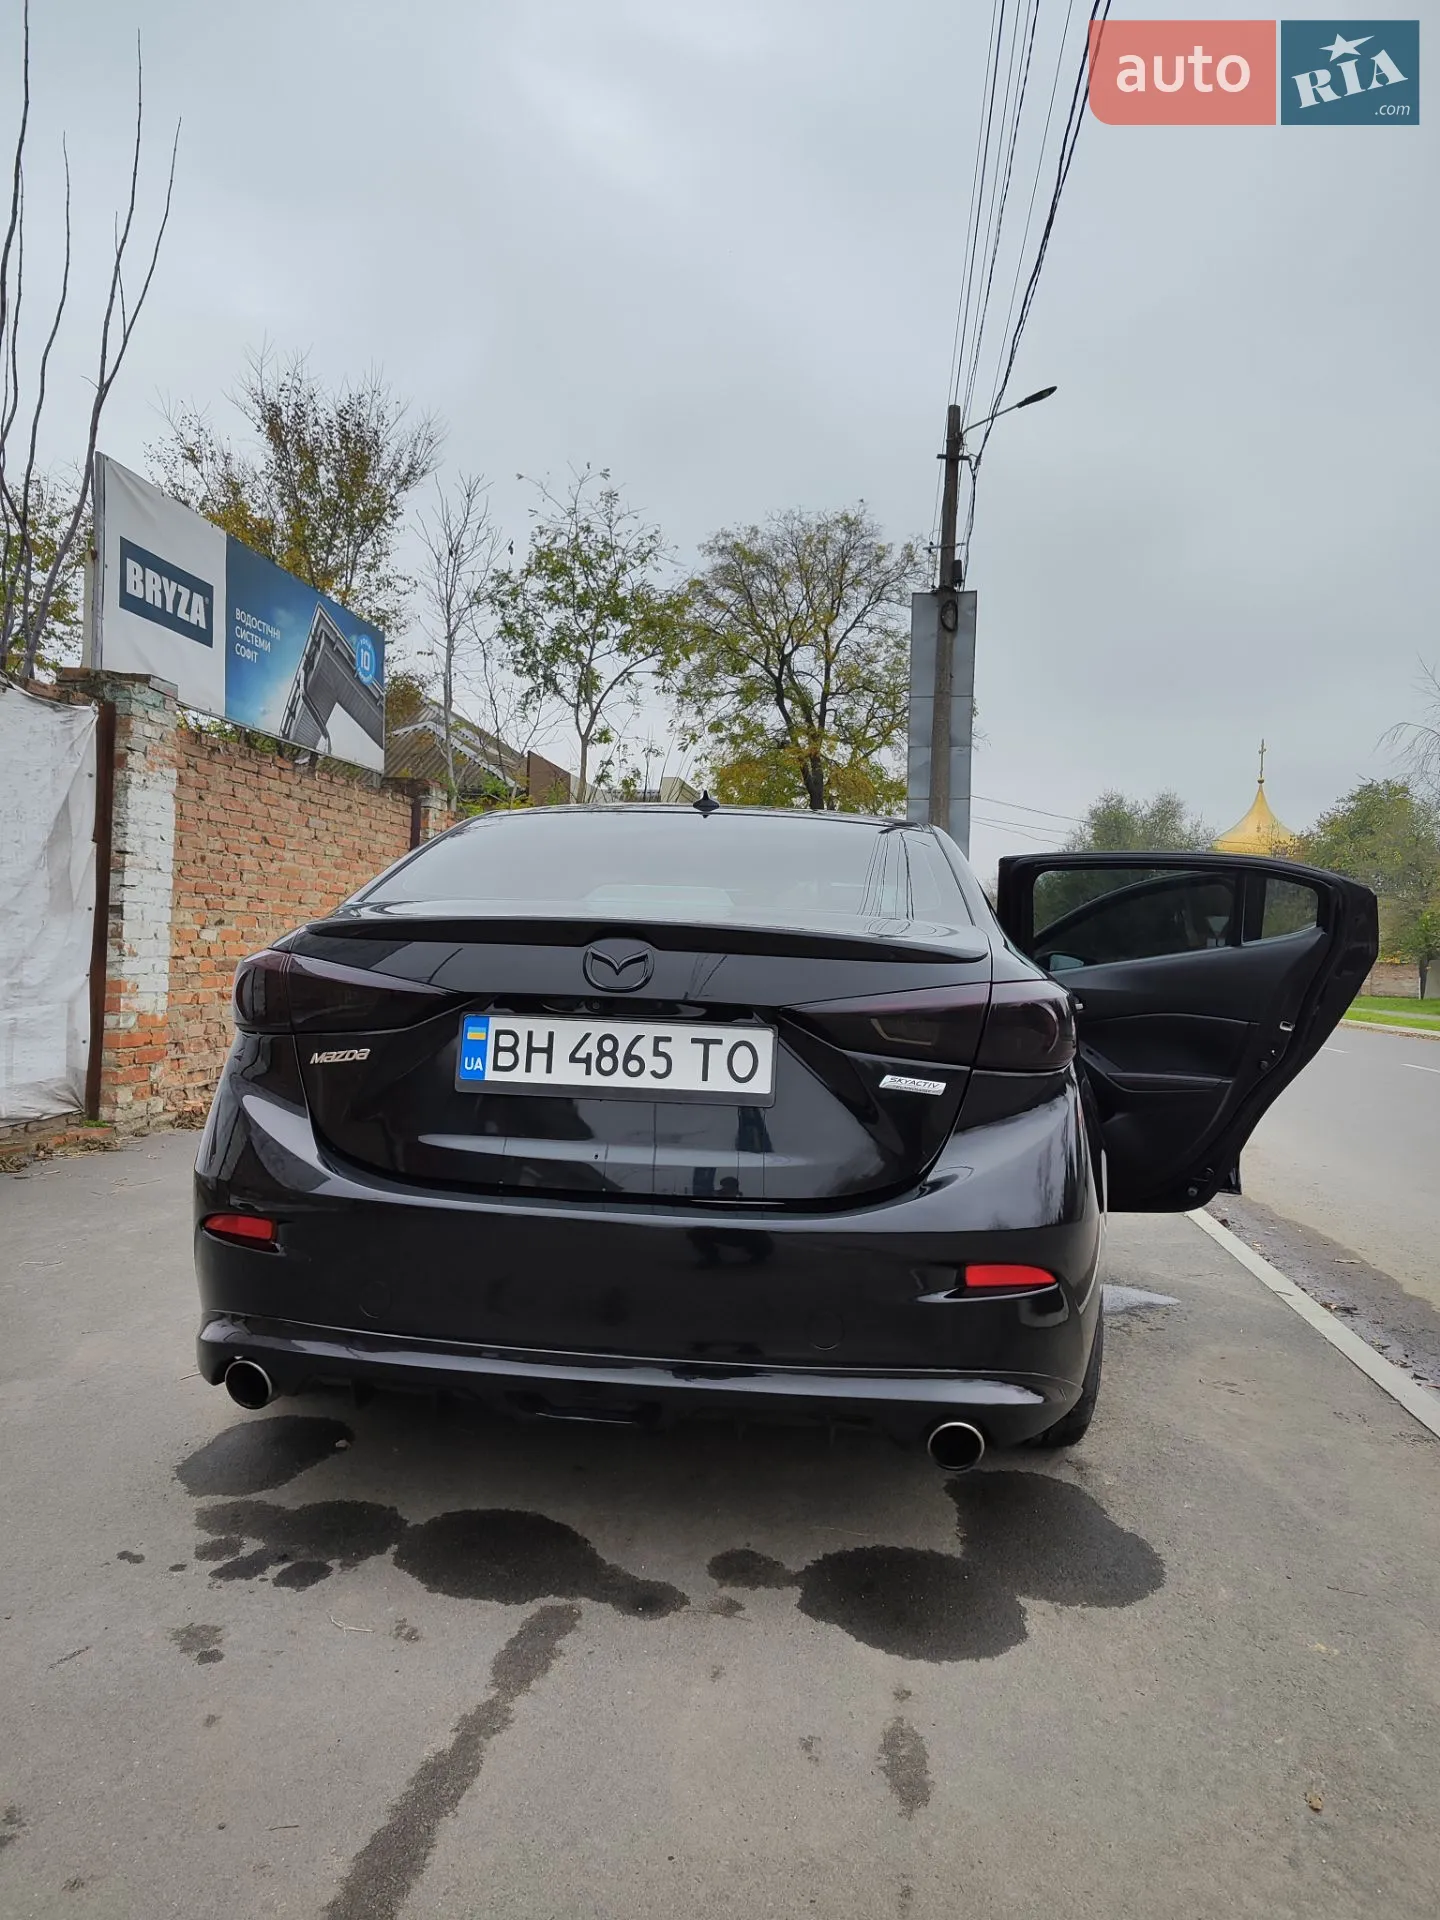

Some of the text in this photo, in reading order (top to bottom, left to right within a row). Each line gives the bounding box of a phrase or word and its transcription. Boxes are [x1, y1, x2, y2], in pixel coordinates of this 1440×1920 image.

[126, 557, 206, 629] BRYZA
[235, 626, 270, 653] СИСТЕМИ
[361, 648, 370, 671] 10
[464, 1057, 483, 1071] UA
[492, 1029, 758, 1083] BH 4865 TO
[889, 1077, 940, 1088] SKYACTIV
